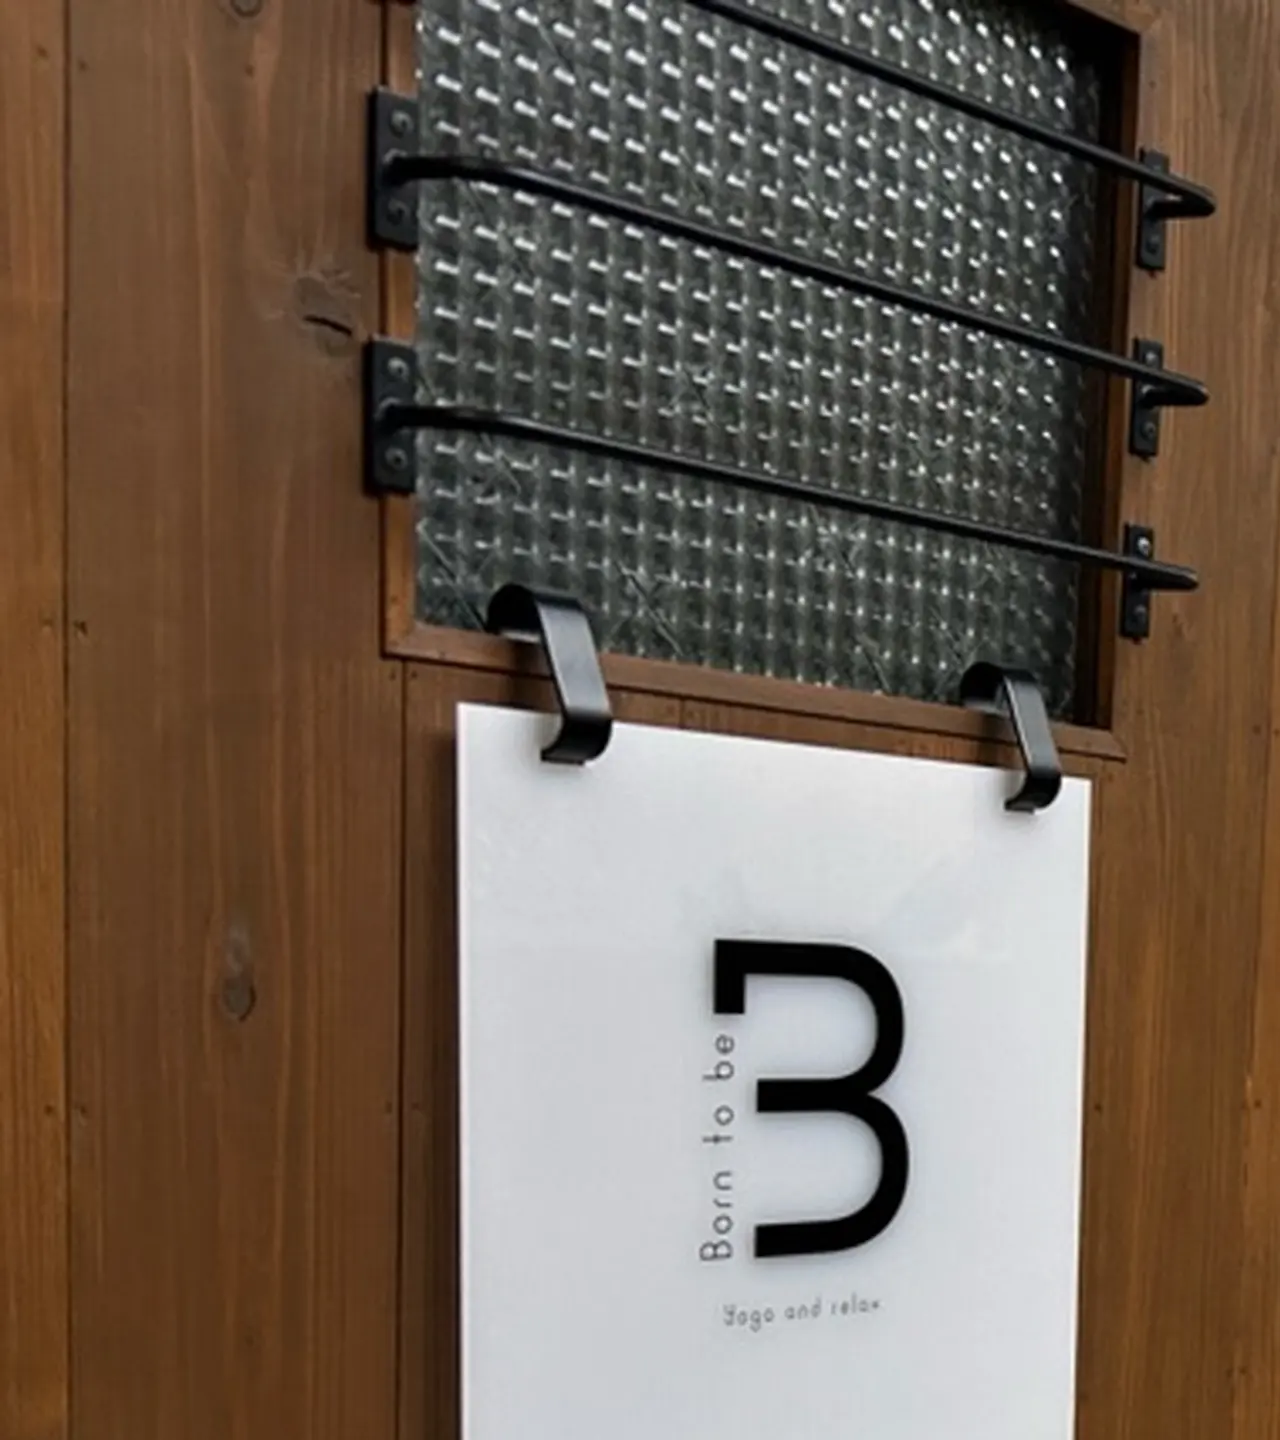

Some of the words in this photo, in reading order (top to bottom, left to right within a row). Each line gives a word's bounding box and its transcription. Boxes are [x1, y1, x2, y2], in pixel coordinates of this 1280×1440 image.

[702, 1034, 736, 1081] be
[702, 1104, 735, 1143] to
[699, 1170, 734, 1262] Born
[784, 1296, 822, 1319] and
